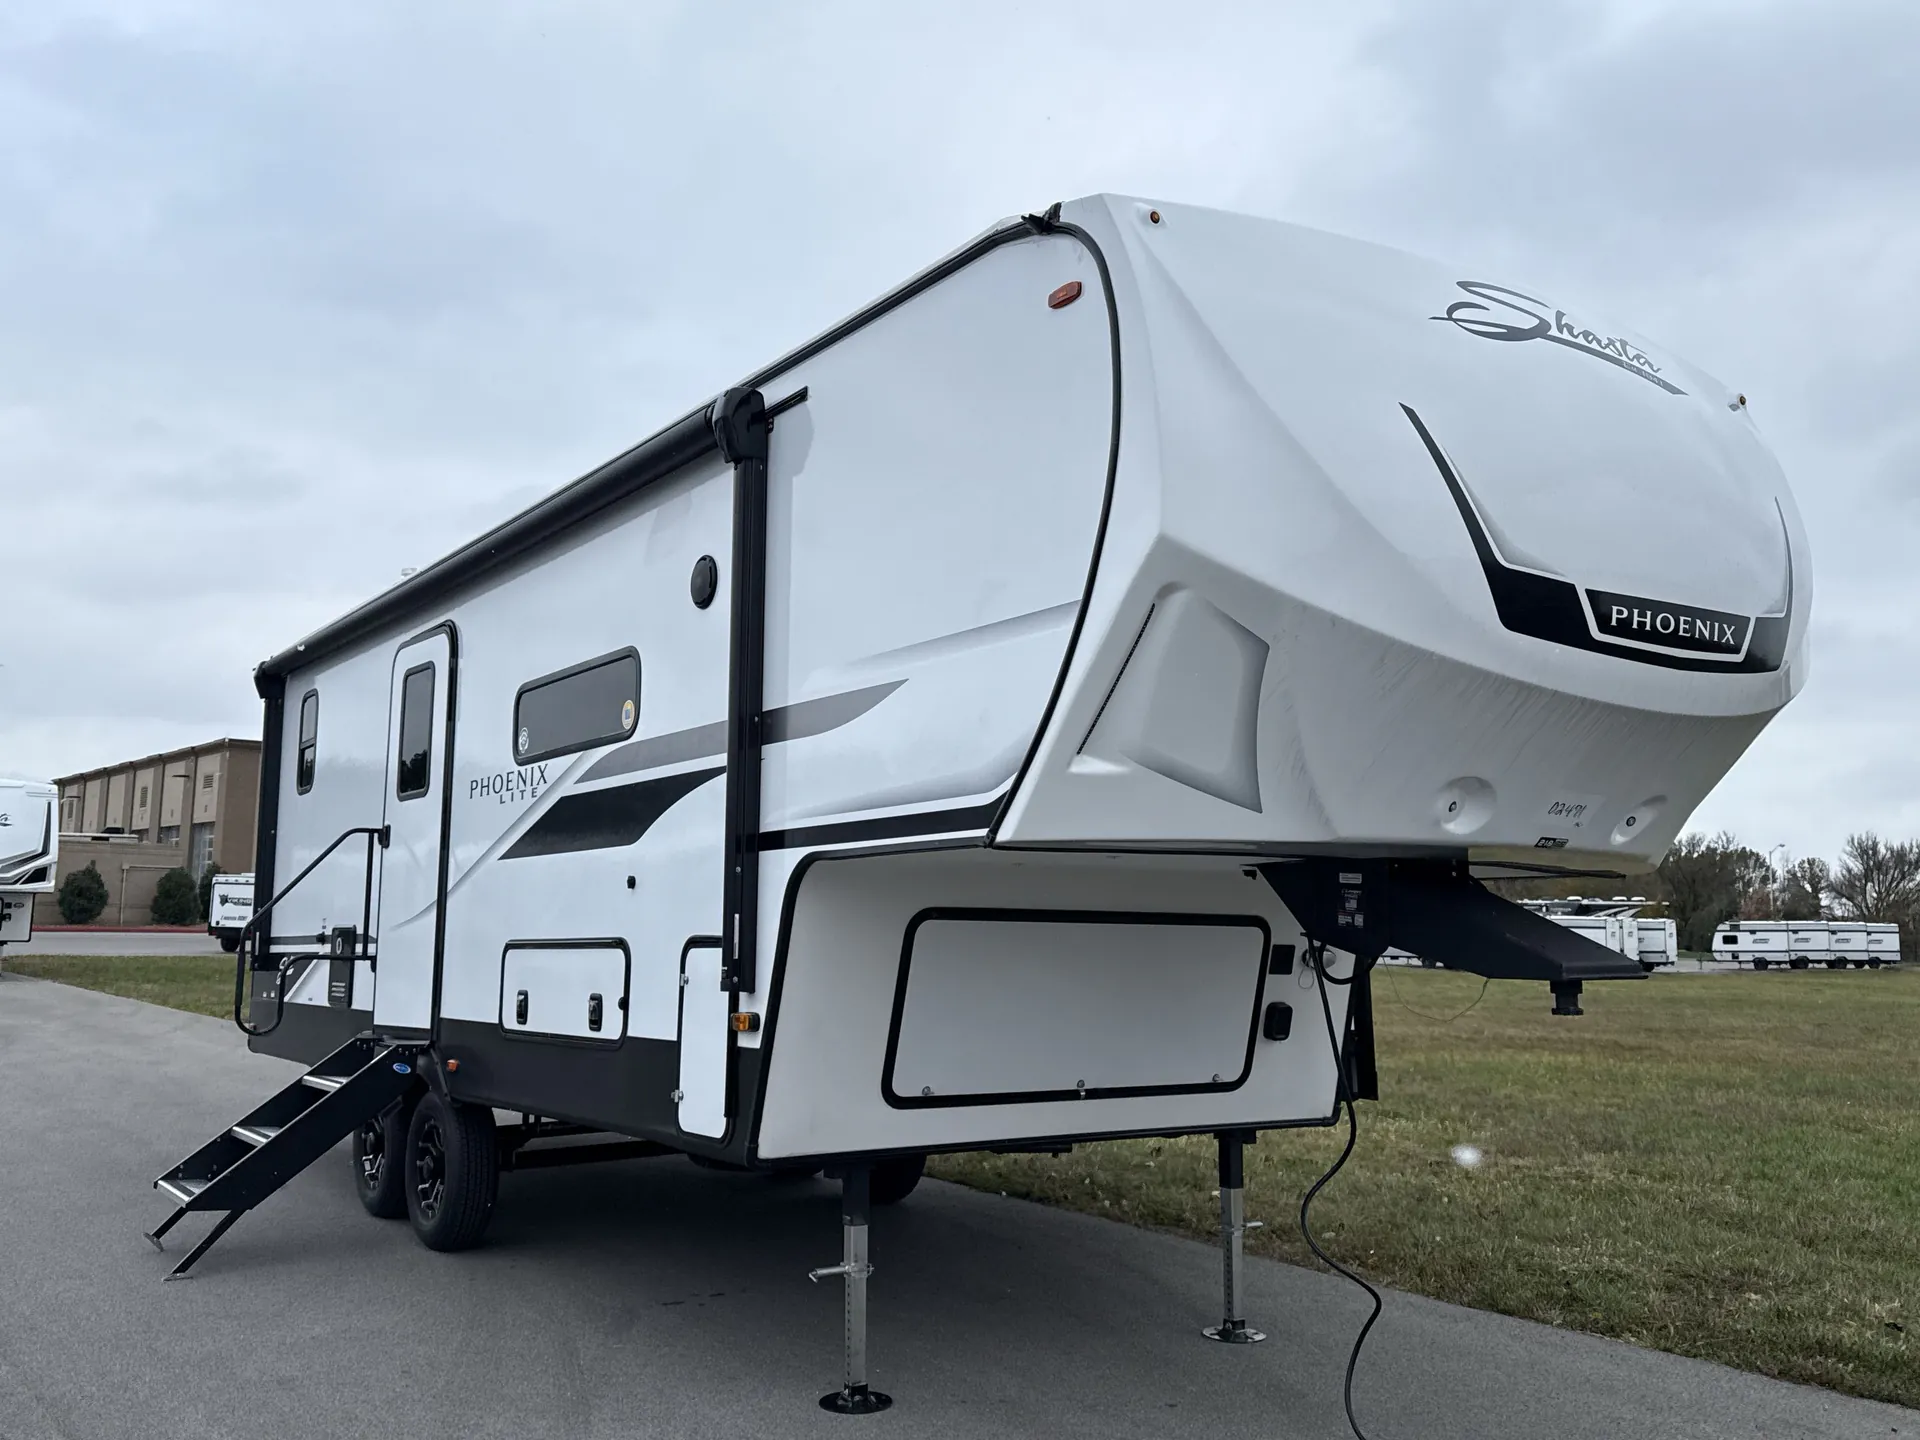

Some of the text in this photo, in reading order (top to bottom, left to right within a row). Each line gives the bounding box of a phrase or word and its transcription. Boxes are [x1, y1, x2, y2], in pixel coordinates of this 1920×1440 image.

[1432, 281, 1672, 384] Shasta
[1610, 605, 1736, 645] PHOENIX
[469, 763, 548, 799] PHOENIX
[499, 787, 538, 804] LITE
